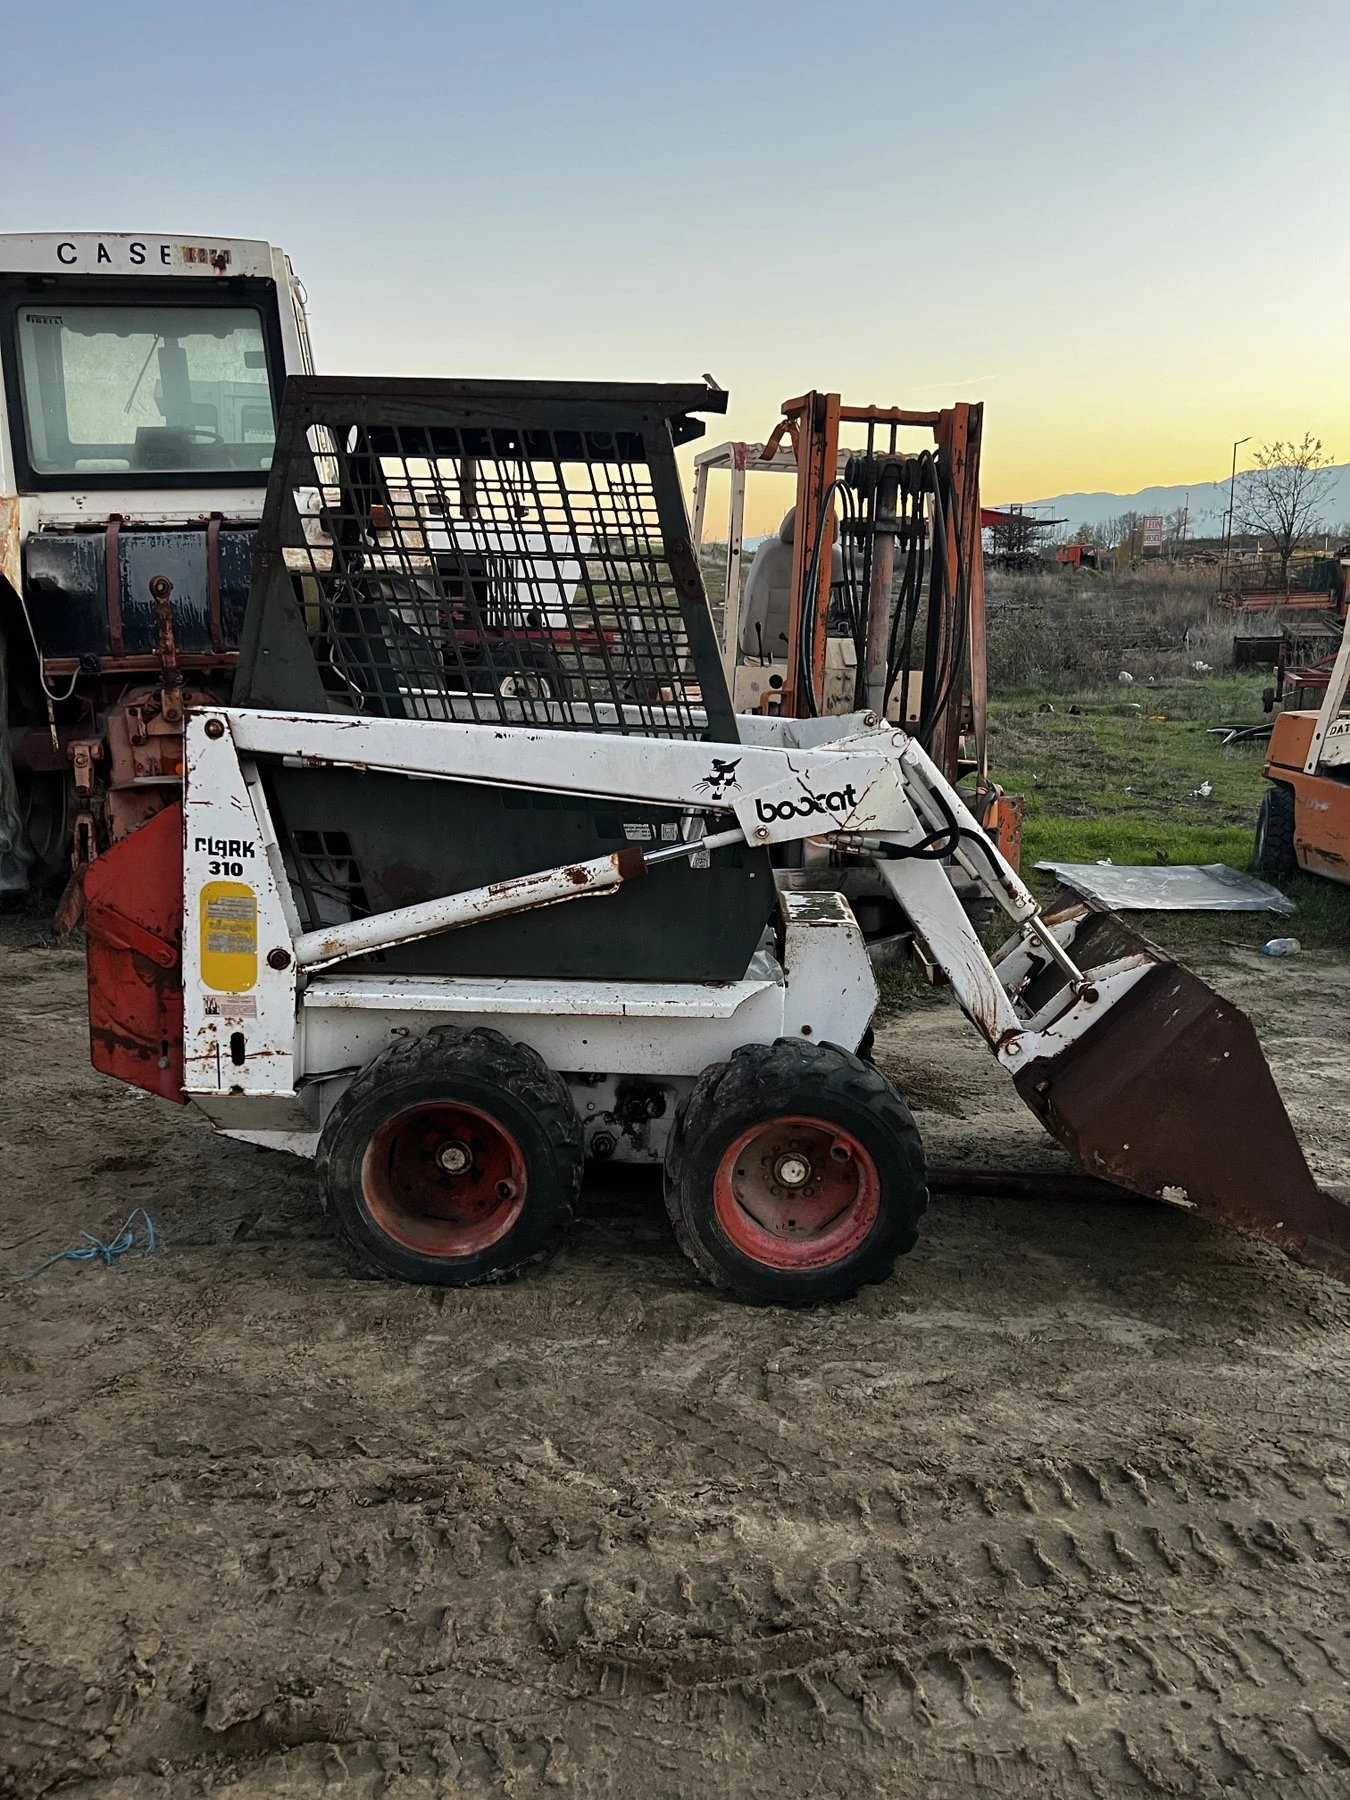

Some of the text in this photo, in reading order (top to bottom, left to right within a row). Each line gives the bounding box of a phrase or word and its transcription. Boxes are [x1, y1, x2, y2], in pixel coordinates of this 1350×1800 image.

[57, 242, 171, 265] CASE
[755, 783, 858, 823] bobcat
[195, 836, 255, 859] CLARK
[208, 860, 244, 877] 310
